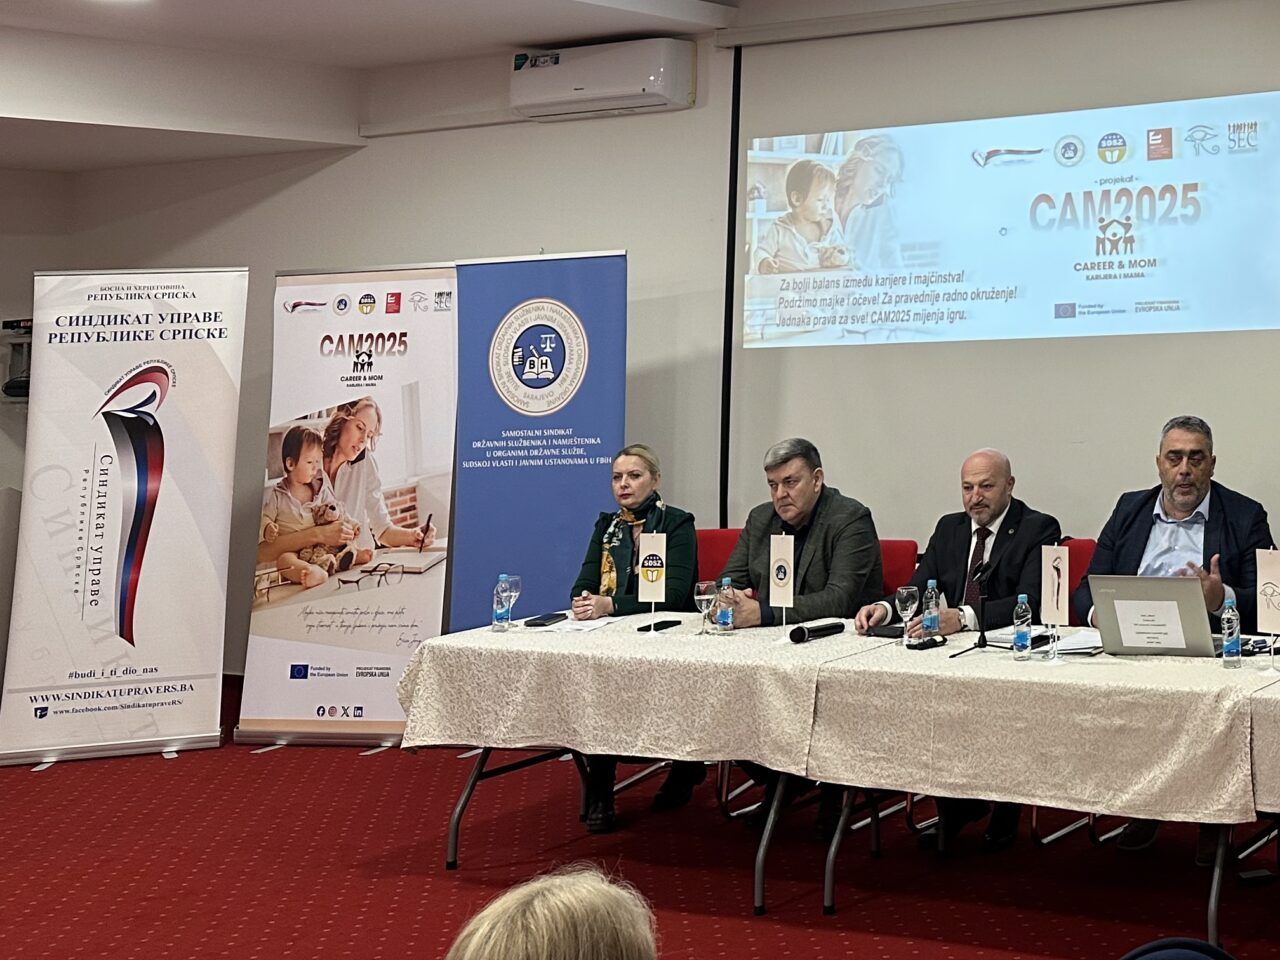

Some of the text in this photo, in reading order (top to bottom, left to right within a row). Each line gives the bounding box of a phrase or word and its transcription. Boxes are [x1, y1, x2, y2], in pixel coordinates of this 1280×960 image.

[1029, 183, 1201, 231] CAM2025
[1073, 258, 1157, 272] CAREER & MOM
[780, 278, 791, 292] Za
[792, 277, 811, 293] bolji
[812, 277, 841, 290] balans
[875, 274, 907, 289] karijere
[914, 270, 965, 287] majčinstva!
[1085, 273, 1117, 281] KARIJERA
[87, 291, 196, 301] РЕПУБЛИКА СРПСКА
[820, 295, 845, 309] majke
[881, 292, 893, 305] Za
[894, 290, 940, 307] pravednije
[942, 289, 968, 302] radno
[970, 286, 1018, 303] okruženje!
[55, 311, 223, 328] СИНДИКАТ УПРАВЕ
[776, 308, 967, 328] Jednaka prava za sve! CAM2025 mijenja igru.
[47, 327, 228, 344] РЕПУБЛИКЕ СРПСКЕ
[320, 332, 408, 357] CAM2025
[501, 428, 573, 438] SAMOSTALNI SINDIKAT
[472, 439, 507, 448] DRŽAVNIH
[508, 437, 547, 447] SLUŽBENIKA
[552, 436, 602, 446] NAMJEŠTENIKA
[493, 449, 528, 457] ORGANIMA
[530, 446, 560, 457] DRŽAVNE
[561, 446, 587, 456] SLUŽBE,
[462, 460, 491, 468] SUDSKOJ
[492, 459, 514, 467] VLASTI
[519, 459, 543, 467] JAVNIM
[544, 457, 589, 466] USTANOVAMA
[89, 454, 113, 607] Синдикат управе
[29, 683, 194, 704] WWW.SINDIKATUPRAVERS.BA
